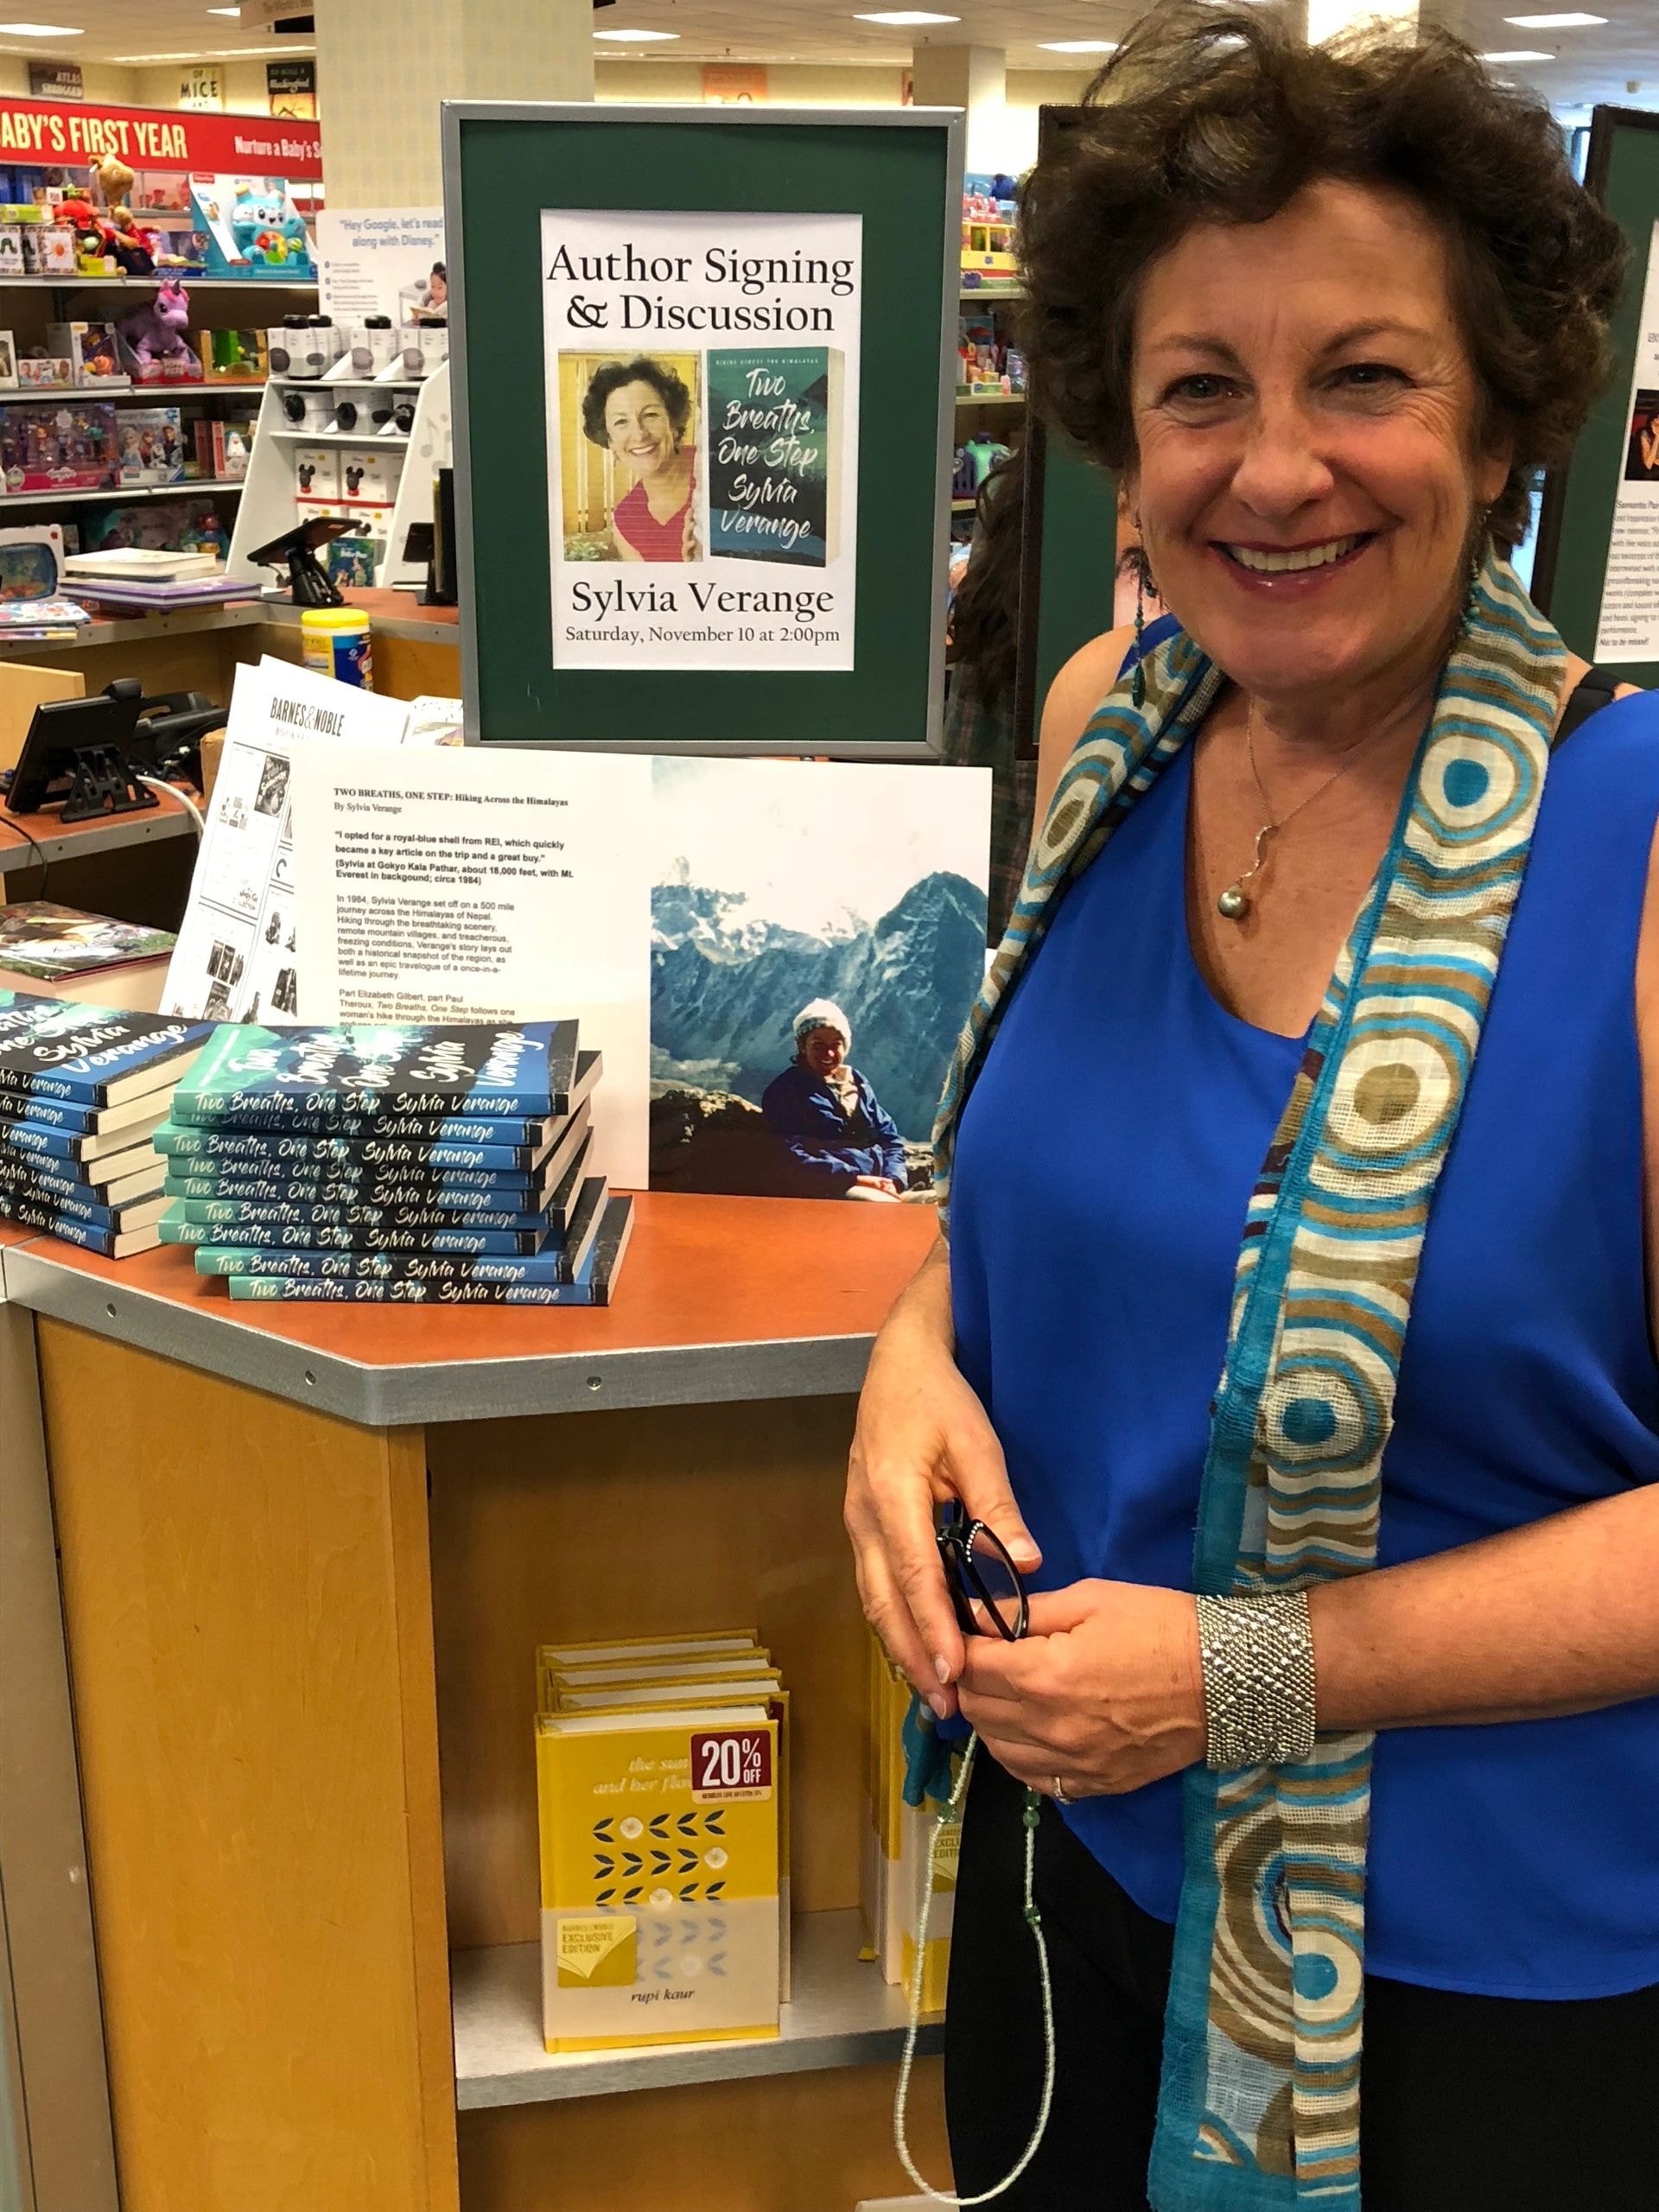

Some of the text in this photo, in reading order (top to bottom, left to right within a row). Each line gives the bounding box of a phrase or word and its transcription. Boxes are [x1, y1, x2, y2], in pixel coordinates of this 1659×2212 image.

[180, 80, 219, 99] MICE
[68, 117, 130, 156] FIRST
[133, 122, 188, 159] YEAR
[234, 136, 272, 156] Nurture
[273, 143, 281, 156] a
[281, 139, 312, 161] Baby's
[546, 243, 855, 296] Author Signing
[567, 295, 835, 331] & Discussion
[746, 367, 786, 398] Two
[722, 398, 815, 435] Breaths,
[718, 435, 818, 477] One Step
[728, 474, 798, 510] Sylvia
[721, 504, 810, 549] Verange
[571, 579, 835, 623] Sylvia Verange
[565, 626, 840, 645] Saturday, November 10 at 2:00pm
[334, 801, 402, 814] By Sylvia Verange
[358, 789, 403, 798] BREATHS,
[454, 793, 482, 803] Hiking
[525, 797, 568, 806] Himalayas
[344, 830, 369, 841] opted
[371, 831, 383, 840] for
[392, 833, 436, 844] royal-blue
[532, 840, 564, 849] quickly
[334, 845, 369, 854] became
[378, 847, 394, 856] key
[395, 848, 423, 856] article
[454, 850, 470, 860] trip
[497, 853, 520, 862] great
[334, 859, 365, 869] (Sylvia
[377, 861, 406, 871] Gokyo
[429, 863, 460, 873] Pathar,
[488, 866, 517, 875] 18,000
[335, 869, 369, 878] Everest
[434, 874, 455, 883] circa
[458, 875, 481, 885] 1984)
[336, 906, 365, 915] journey
[412, 909, 454, 919] Himalayas
[371, 896, 395, 906] Sylvia
[397, 898, 430, 908] Verange
[34, 1025, 130, 1061] Sylvia
[61, 1024, 188, 1072] Verange
[467, 1030, 544, 1086] Verange
[22, 1073, 72, 1097] Verange
[195, 1090, 518, 1115] Two Breaths, One Step Sylvia Verange
[174, 1134, 485, 1166] Two Breaths, One Step Sylvia Verange
[48, 1218, 86, 1243] Verange
[178, 1224, 486, 1253] Two Breaths, One Step Sylvia Verange
[216, 1255, 526, 1282] Two Breaths, One Step Sylvia Verange
[249, 1278, 561, 1304] Two Breaths, One Step Sylvia Verange
[658, 1758, 690, 1771] sun
[701, 1738, 761, 1788] 20%
[593, 1777, 626, 1796] and
[743, 1769, 761, 1784] OFF
[562, 1944, 601, 1955] EDITION
[630, 1988, 696, 2005] rupi kaur
